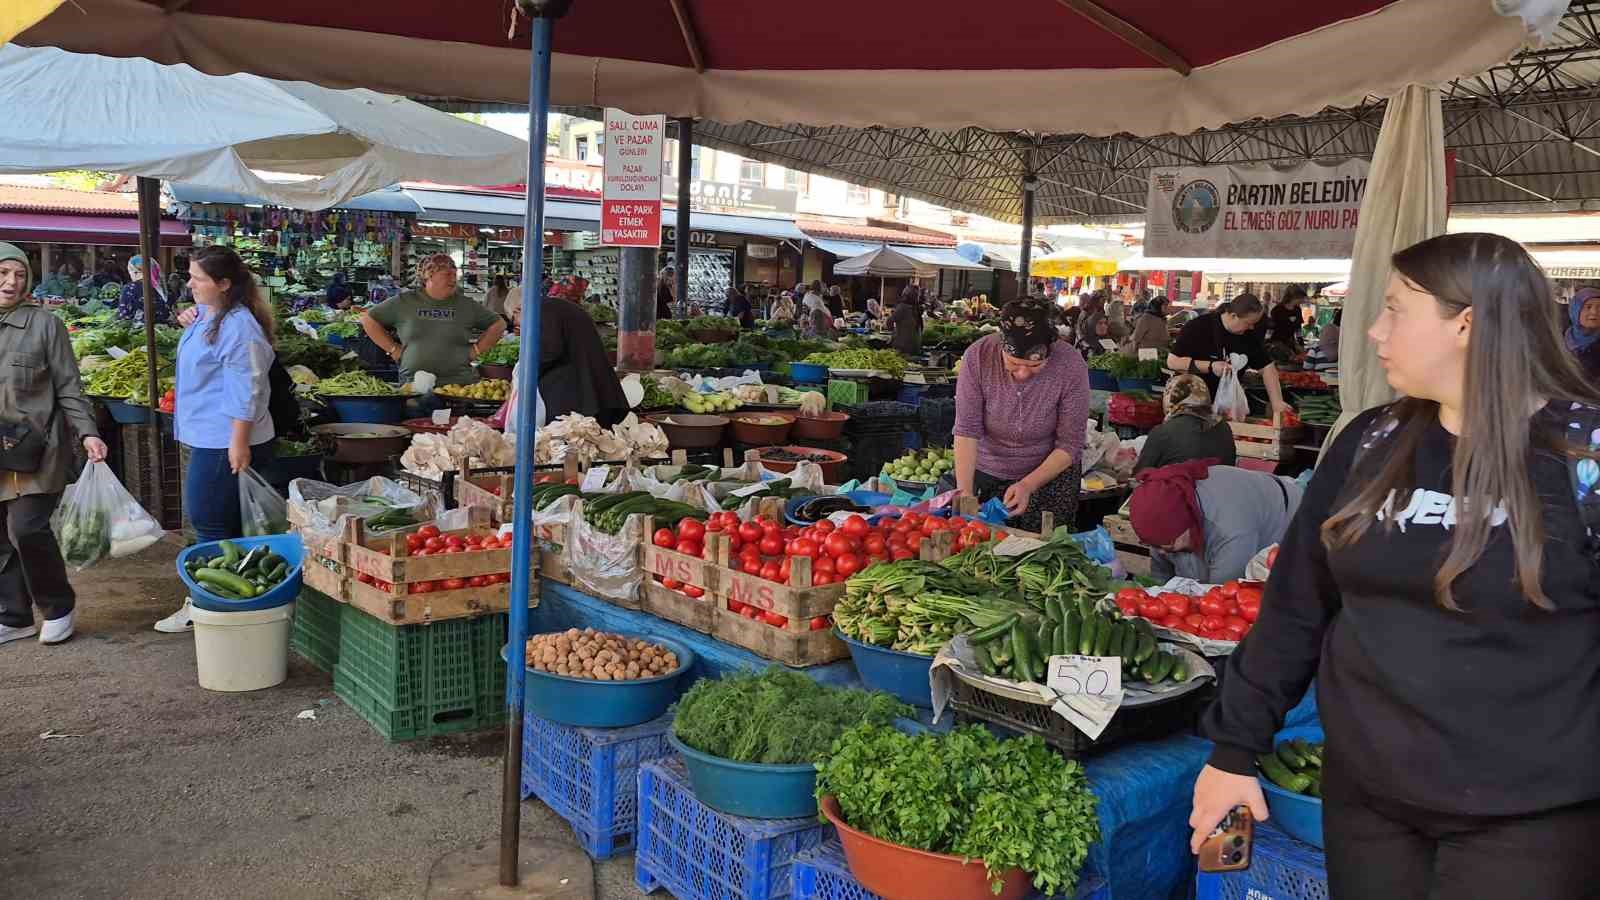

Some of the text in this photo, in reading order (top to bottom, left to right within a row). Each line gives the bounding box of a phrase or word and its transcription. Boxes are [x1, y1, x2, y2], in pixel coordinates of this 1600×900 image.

[632, 120, 658, 131] CUMA
[614, 135, 654, 145] VE PAZAR
[622, 164, 643, 173] PAZAR
[1226, 183, 1287, 206] BARTIN
[609, 204, 654, 216] ARAÇ PARK
[618, 217, 644, 226] ETMEK
[1224, 210, 1239, 231] EL
[1304, 208, 1340, 231] NURU
[614, 229, 648, 239] YASAKTIR
[416, 307, 456, 319] mavi
[655, 553, 693, 583] MS
[730, 576, 775, 610] MS
[1056, 663, 1109, 697] 50
